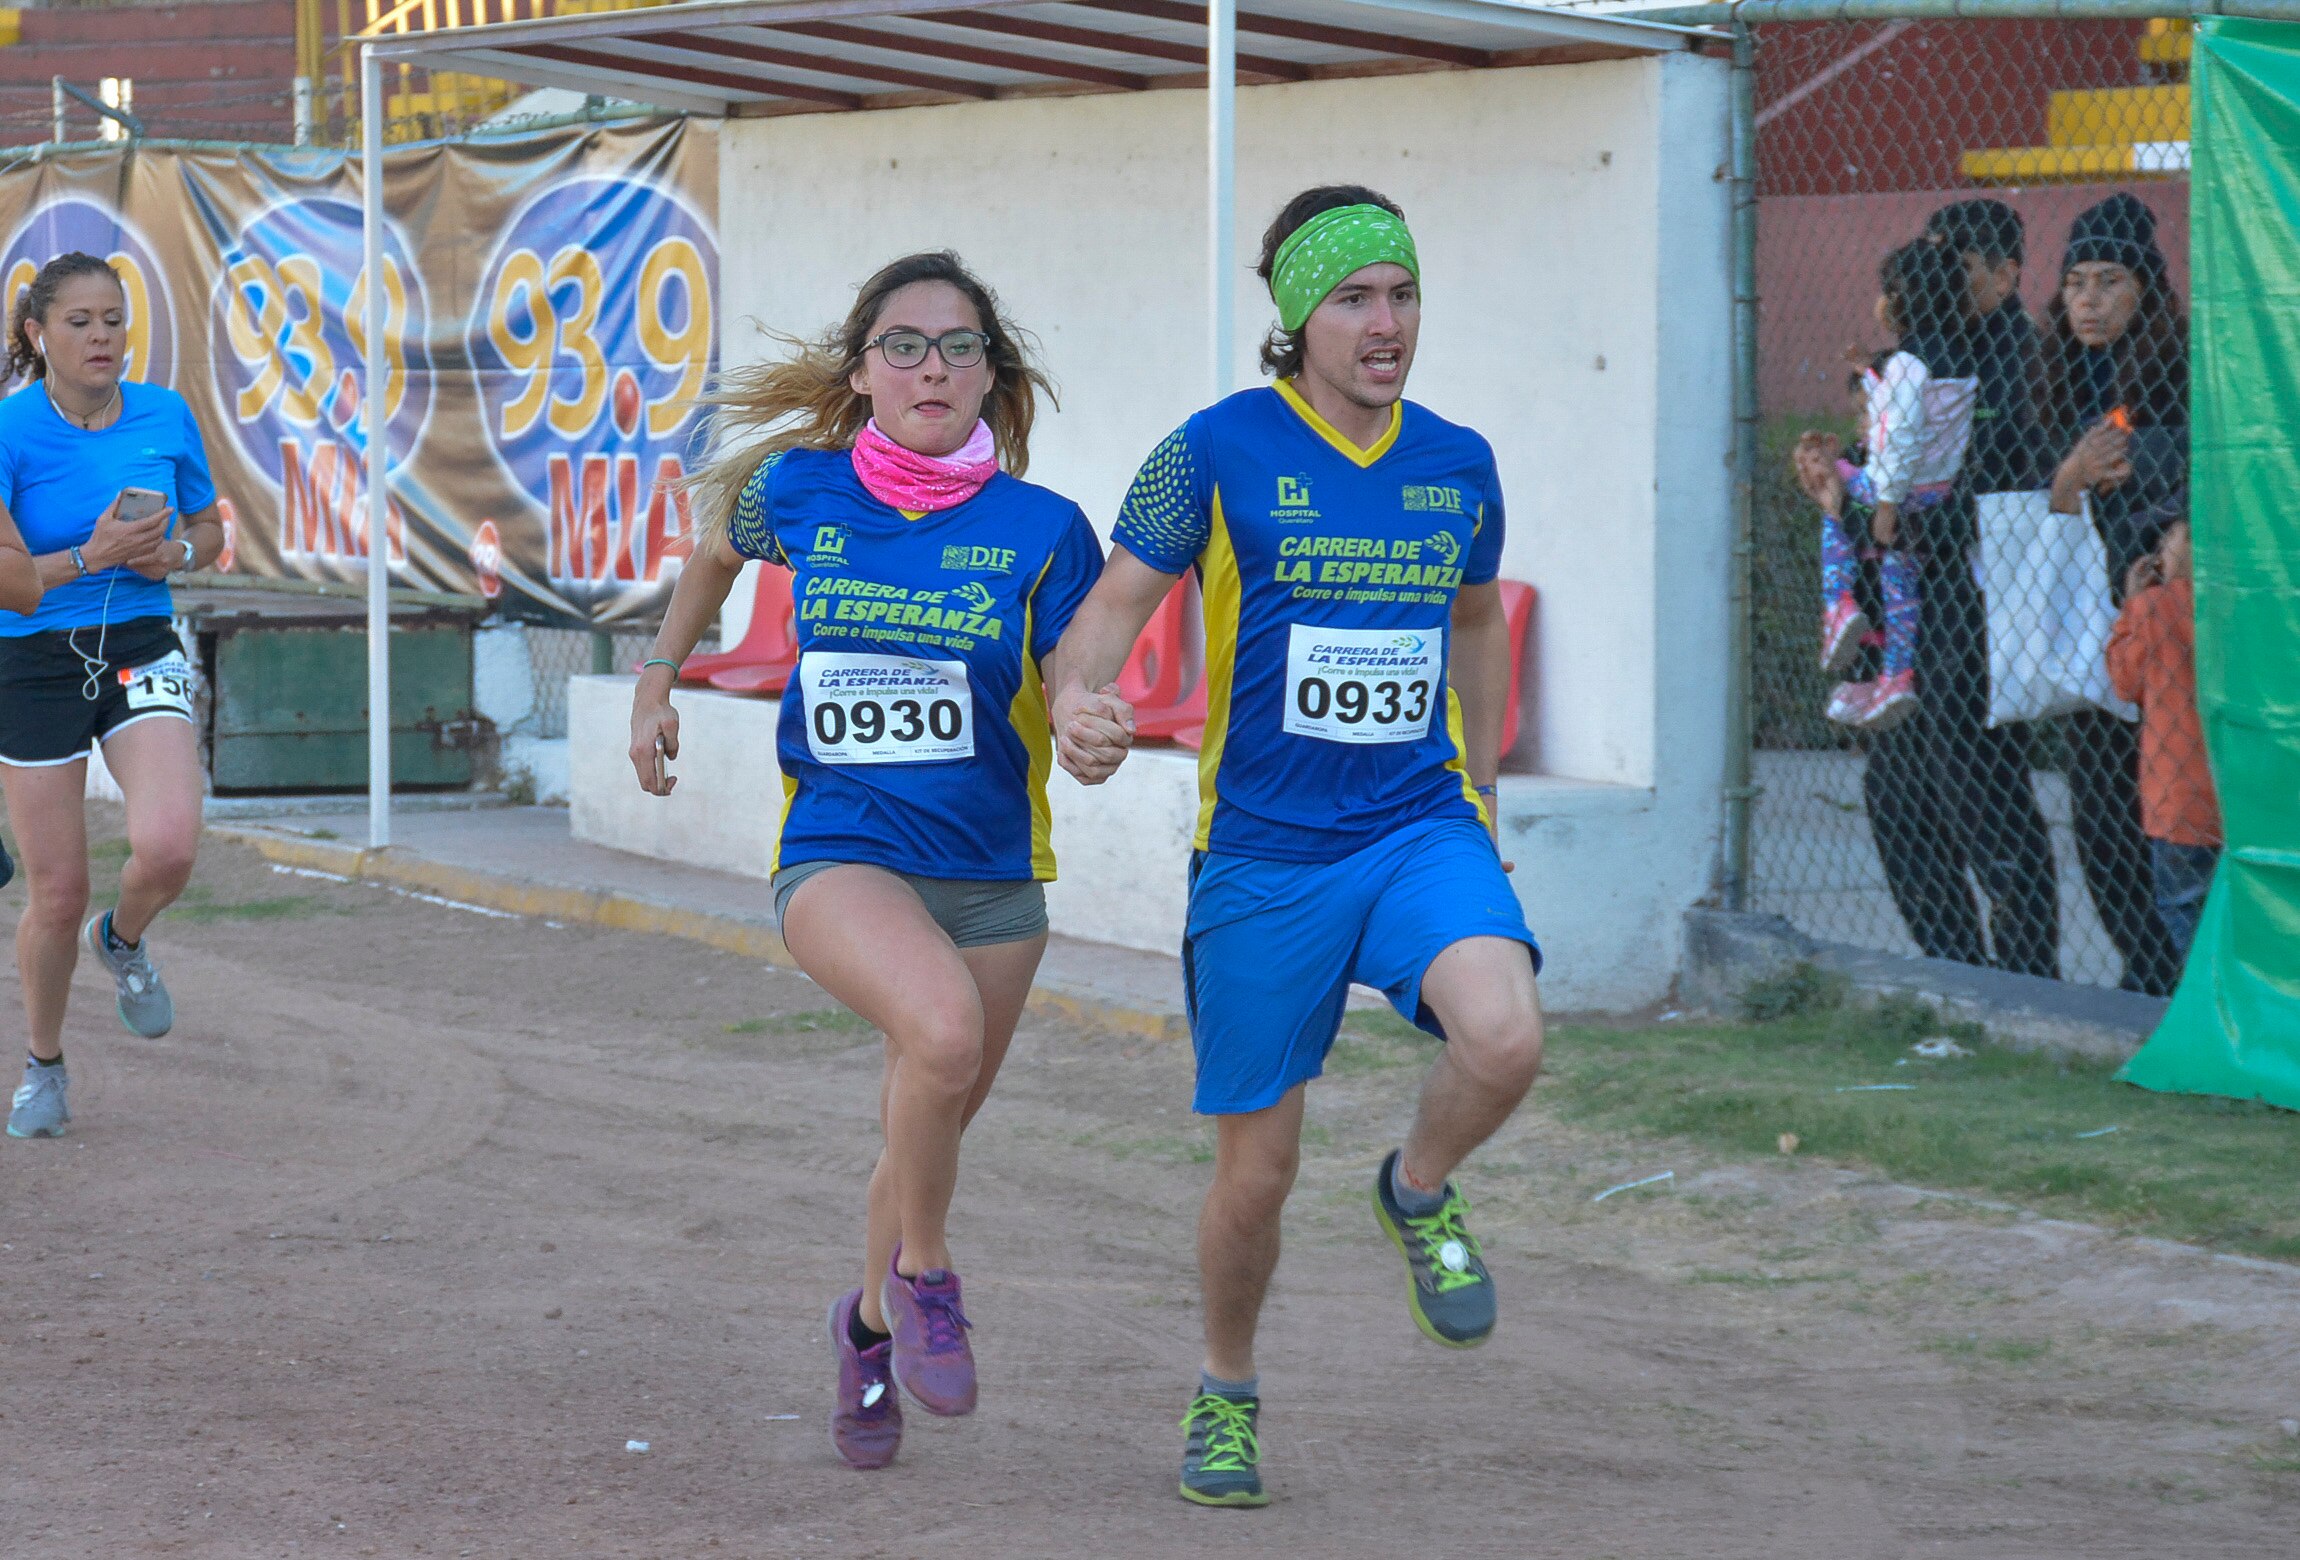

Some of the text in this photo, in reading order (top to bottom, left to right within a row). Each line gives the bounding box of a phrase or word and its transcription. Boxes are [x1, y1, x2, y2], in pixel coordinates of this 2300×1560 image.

[227, 253, 407, 431] 93.9
[488, 235, 712, 440] 93.9
[1426, 486, 1461, 509] DIF
[547, 453, 697, 582] MIA
[1270, 509, 1321, 517] HOSPITAL
[969, 546, 1016, 568] DIF
[1279, 536, 1423, 560] CARRERA DE
[806, 554, 849, 565] HOSPITAL
[1274, 561, 1311, 582] LA
[805, 576, 948, 603] CARRERA DE
[1292, 586, 1448, 605] Corre e impulsa una vida
[801, 599, 1003, 640] LA ESPERANZA
[813, 623, 975, 651] Corre e impulsa una vida
[1307, 653, 1428, 666] LA ESPERANZA
[1312, 644, 1400, 656] CARRERA DE
[818, 677, 949, 687] LA ESPERANZA
[821, 668, 911, 678] CARRERA DE
[829, 688, 858, 699] ¡Corre
[917, 686, 938, 695] vida!
[1297, 677, 1429, 724] 0933
[814, 699, 962, 745] 0930
